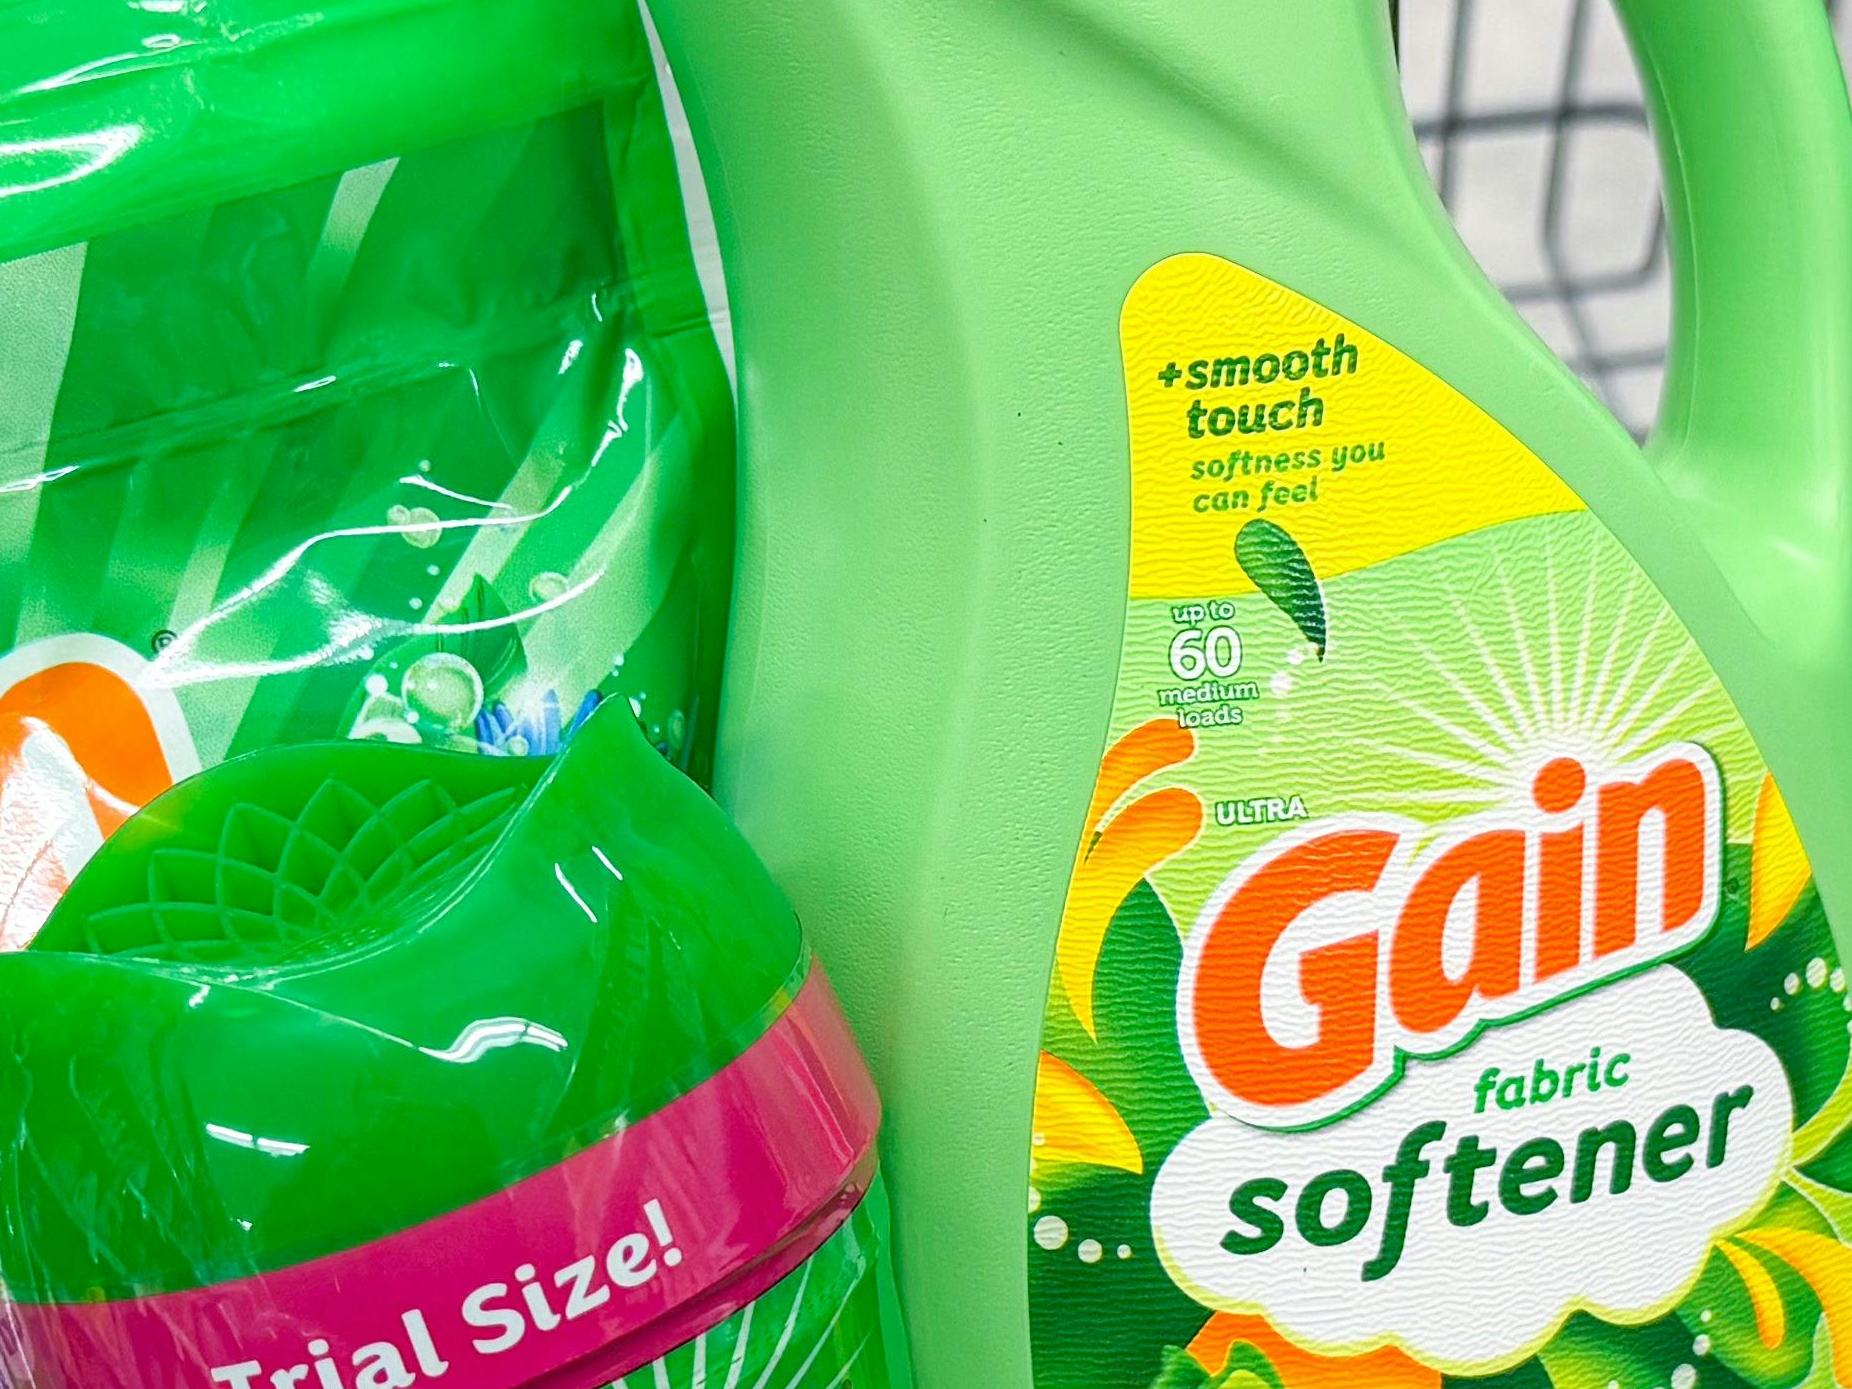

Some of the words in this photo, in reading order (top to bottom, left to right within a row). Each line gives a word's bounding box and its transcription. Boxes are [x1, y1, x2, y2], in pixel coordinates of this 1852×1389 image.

[1157, 332, 1359, 390] +smooth
[1186, 387, 1324, 439] touch
[1191, 447, 1322, 481] softness
[1331, 439, 1387, 472] you
[1192, 487, 1249, 513] can
[1257, 474, 1319, 511] feel
[1171, 603, 1205, 624] up
[1208, 600, 1235, 622] to
[1168, 626, 1243, 681] 60
[1158, 680, 1259, 706] medium
[1178, 703, 1243, 729] loads
[1214, 795, 1309, 827] ULTRA
[1192, 756, 1705, 1106] Gain
[1473, 1047, 1631, 1114] fabric
[1219, 1082, 1754, 1284] softener
[471, 1197, 684, 1358] Size!
